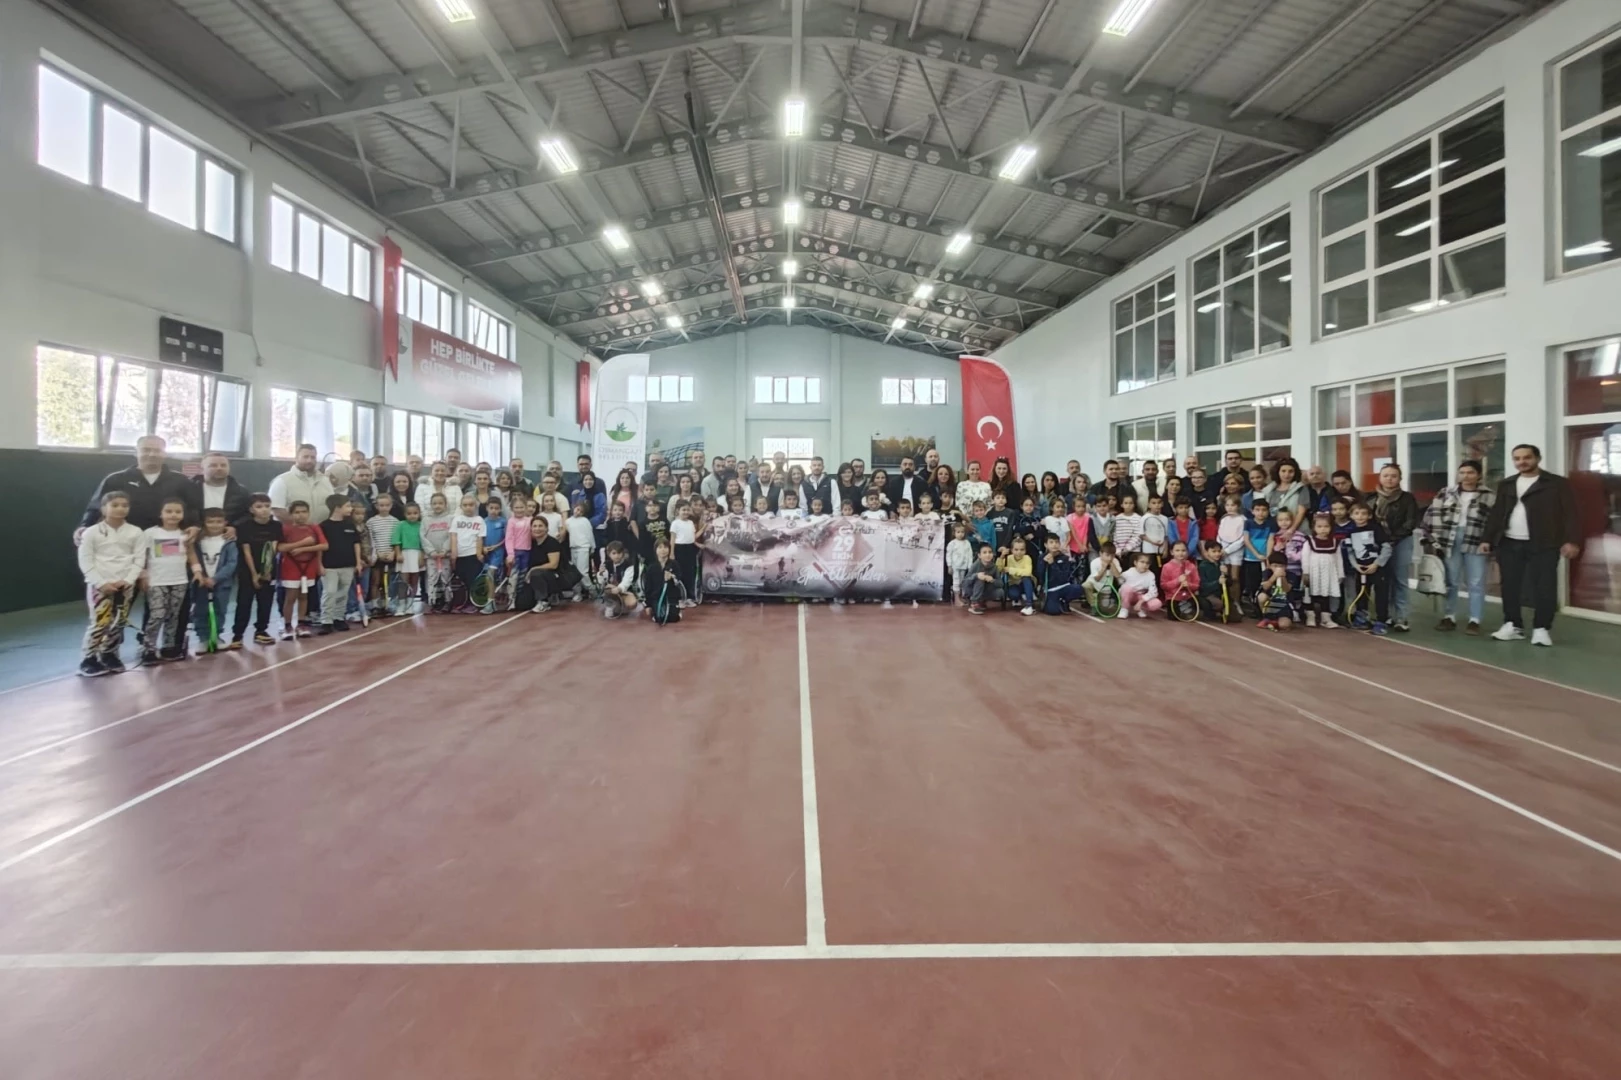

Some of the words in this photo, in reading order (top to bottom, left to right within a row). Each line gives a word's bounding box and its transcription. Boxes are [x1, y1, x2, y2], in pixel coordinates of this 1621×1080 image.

[430, 338, 453, 359] HEP
[455, 346, 496, 376] BİRLİKTE
[832, 535, 855, 552] 29
